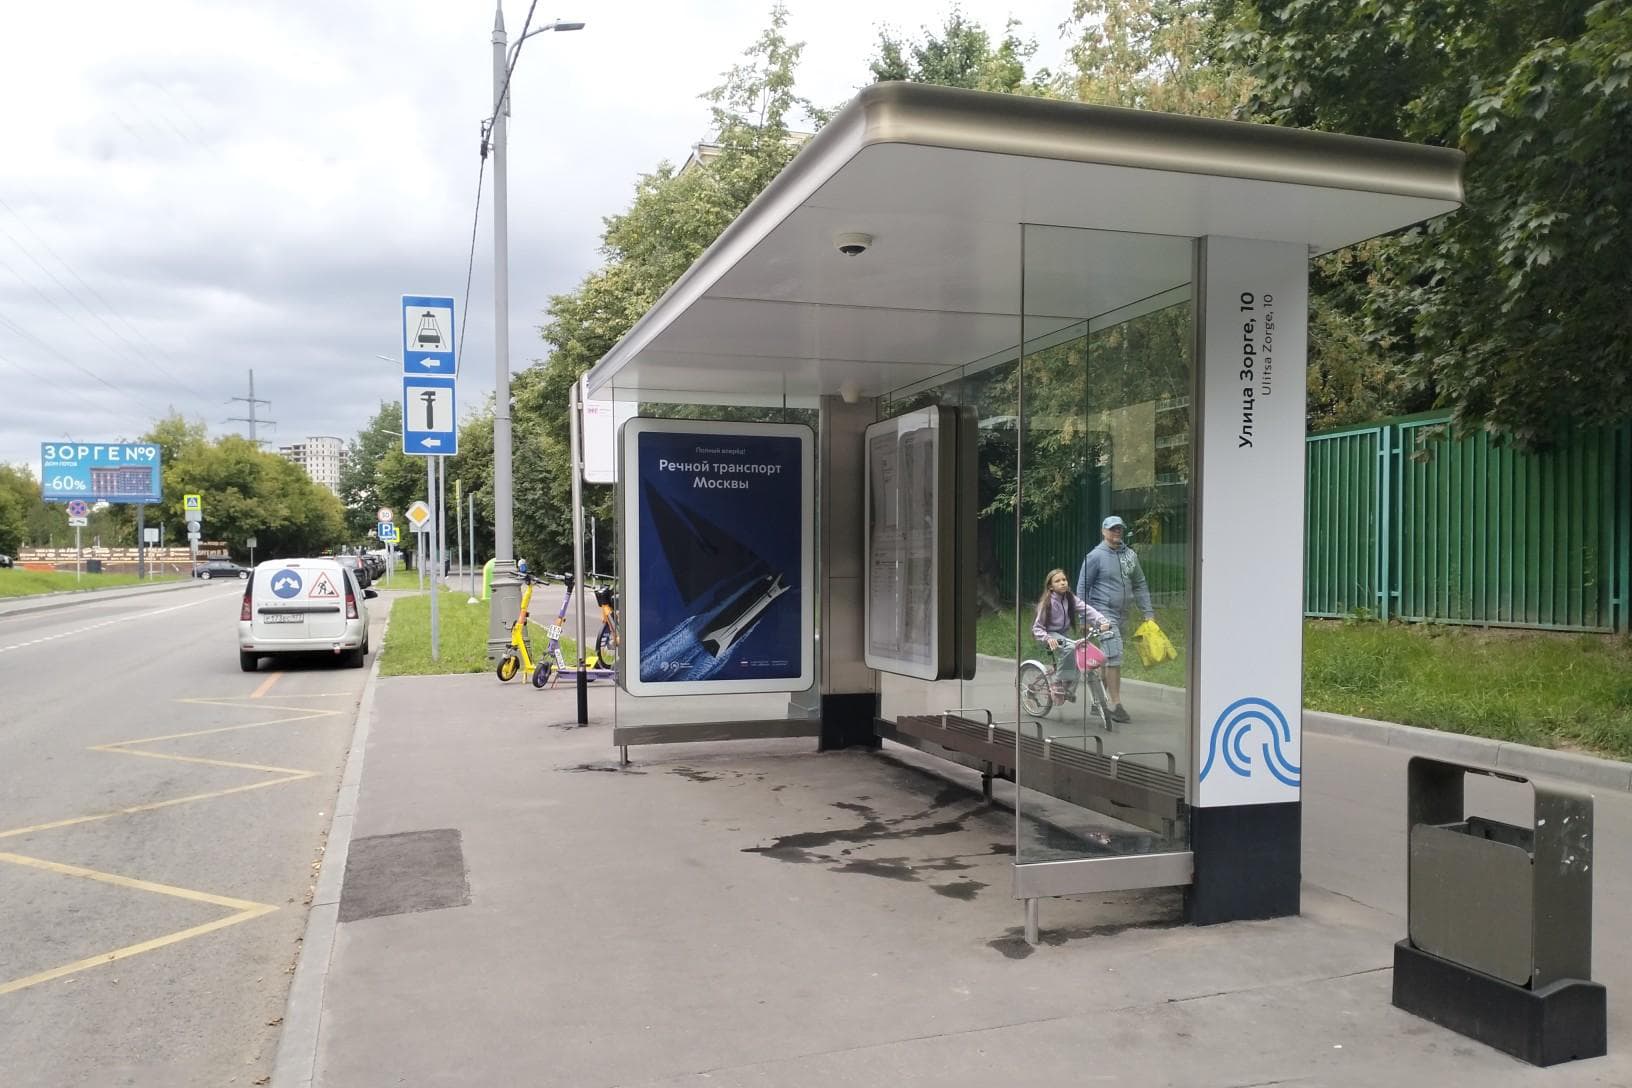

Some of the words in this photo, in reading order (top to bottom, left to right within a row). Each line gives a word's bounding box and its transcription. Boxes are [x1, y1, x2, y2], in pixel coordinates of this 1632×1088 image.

[1240, 292, 1255, 313] 10
[1263, 294, 1274, 308] 10
[1262, 311, 1275, 353] Zorge,
[1239, 318, 1257, 382] Зорге,
[1261, 357, 1272, 396] Ulitsa
[1238, 387, 1256, 449] Улица
[44, 445, 121, 461] ЗОРГЕ
[659, 459, 709, 472] Речной
[712, 462, 782, 476] транспорт
[45, 475, 86, 490] -60%
[693, 476, 749, 489] Москвы
[382, 524, 390, 535] P
